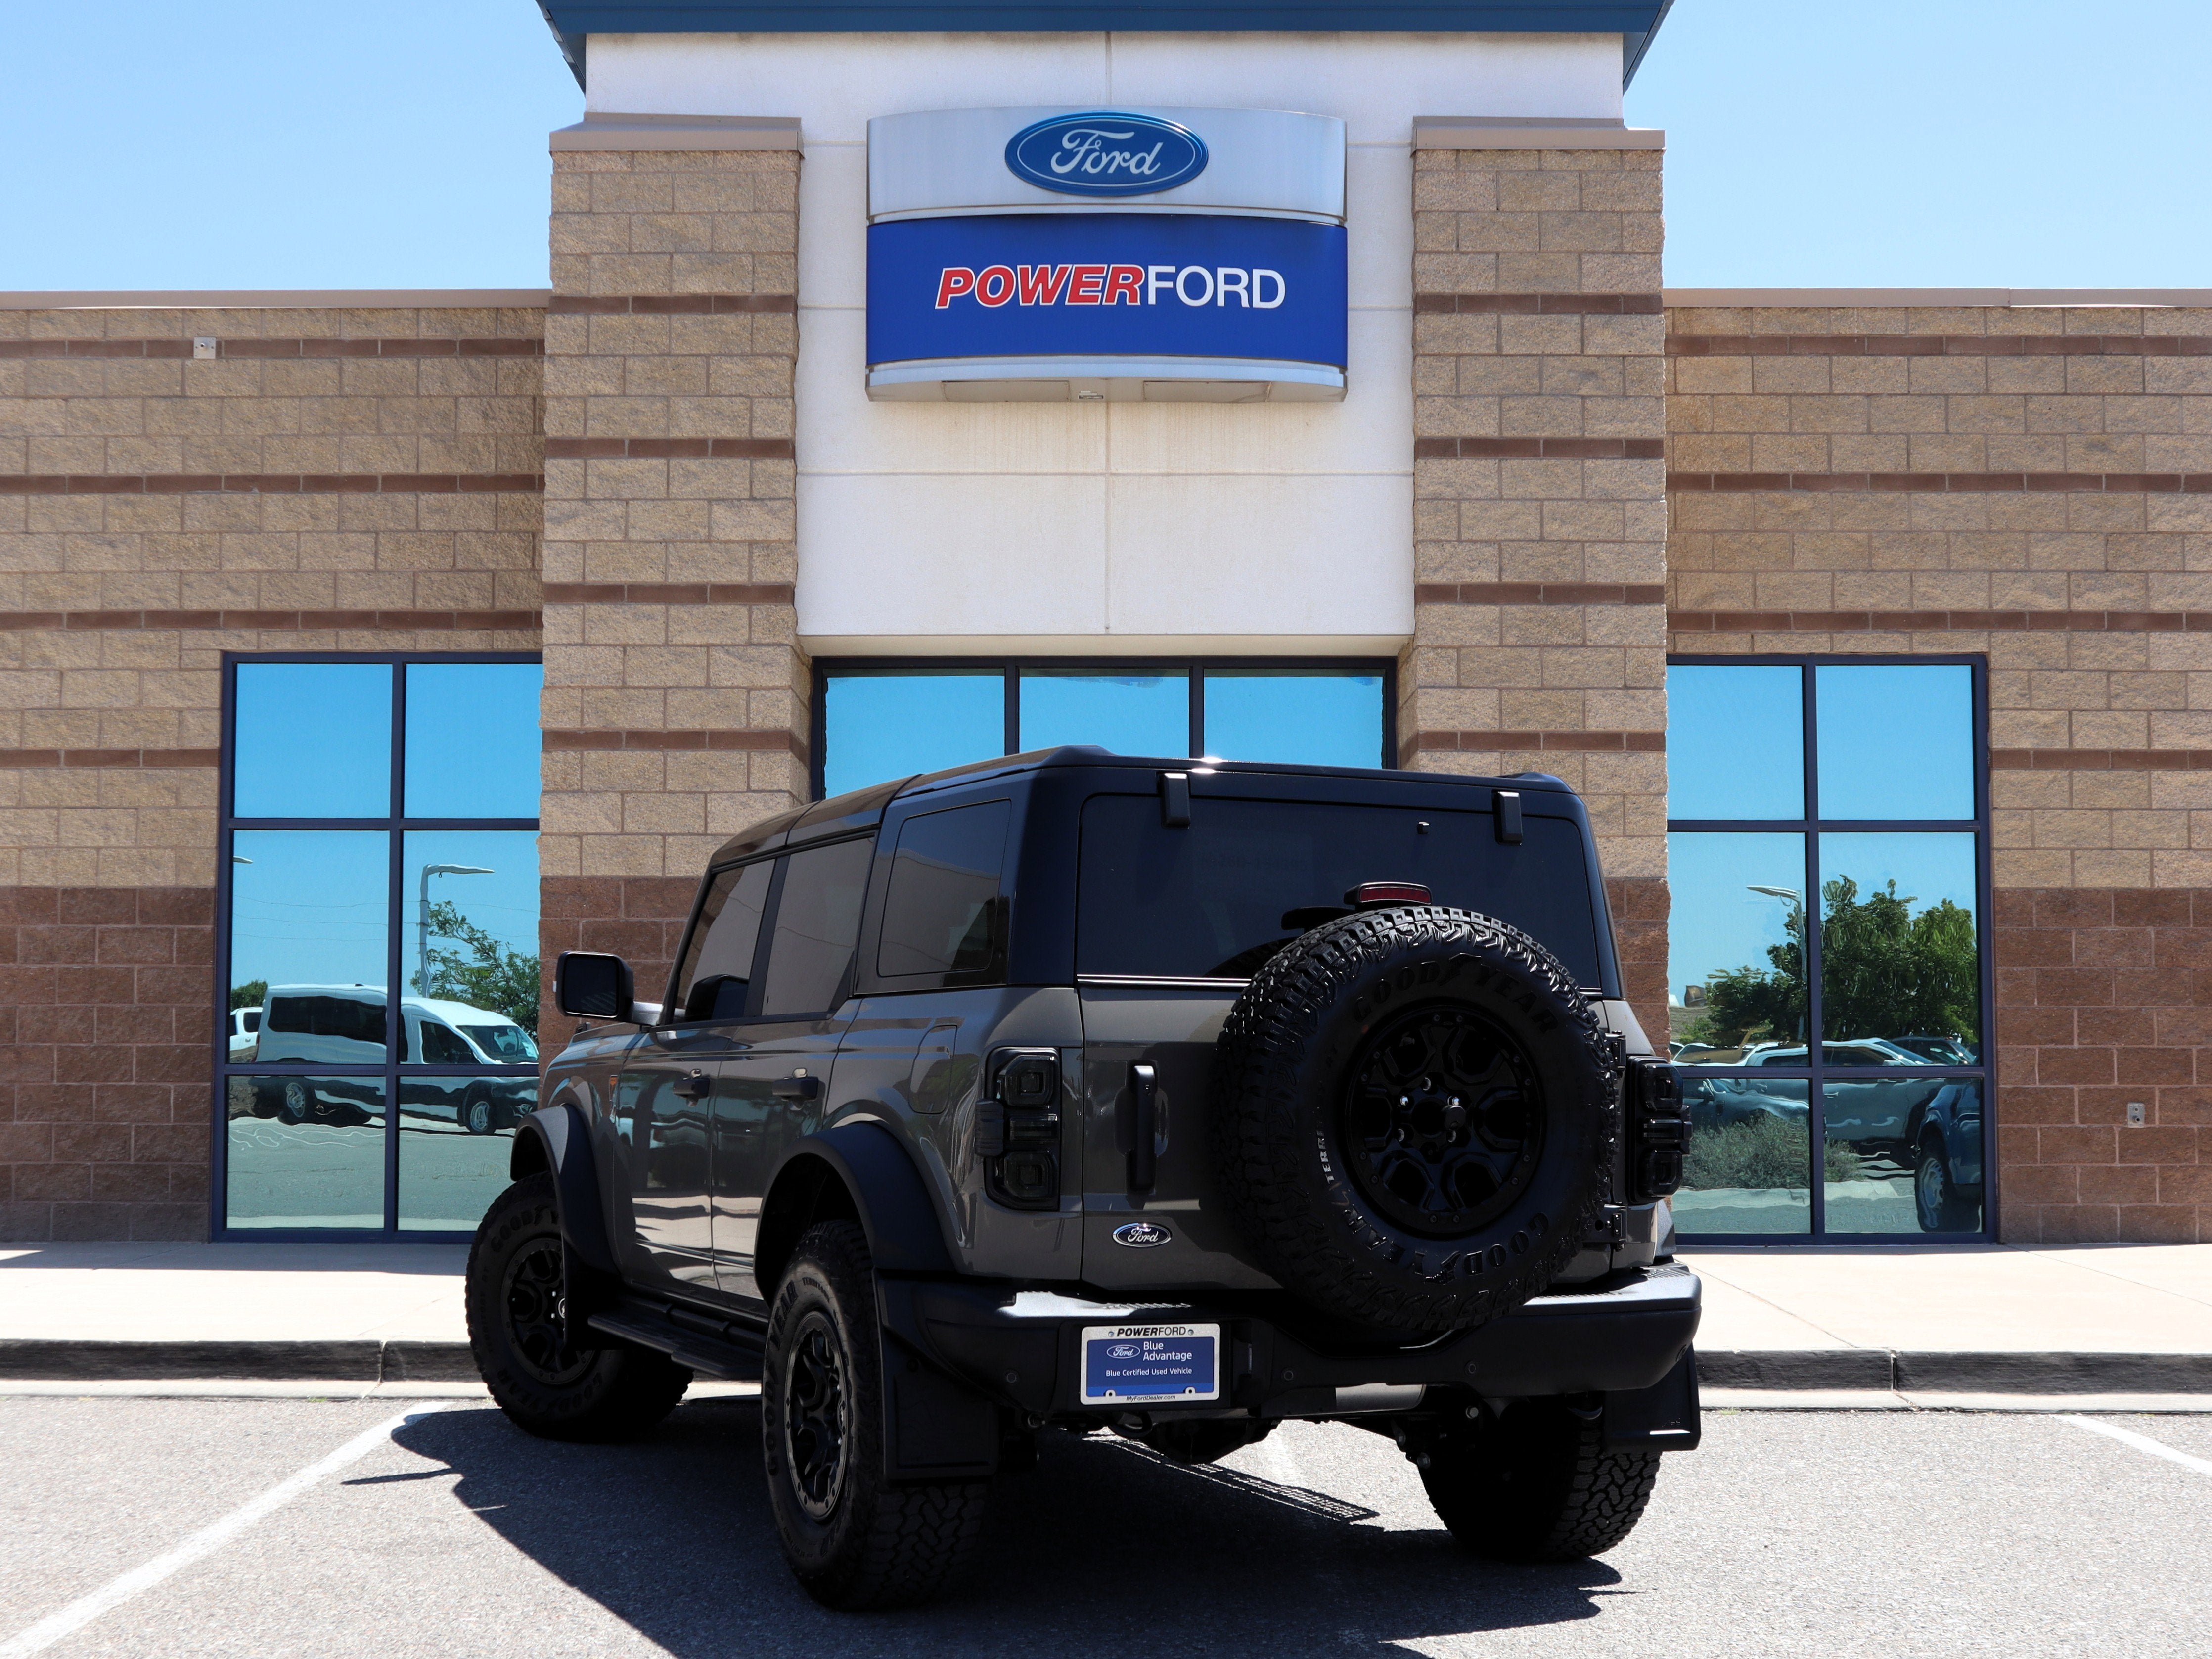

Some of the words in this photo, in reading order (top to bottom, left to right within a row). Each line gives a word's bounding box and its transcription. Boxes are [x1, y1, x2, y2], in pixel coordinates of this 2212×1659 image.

[1050, 128, 1161, 176] Ford
[934, 263, 1286, 310] POWERFORD
[490, 1205, 562, 1253] GOODY
[1127, 1226, 1159, 1242] Ford
[1116, 1326, 1186, 1337] POWERFORD
[1112, 1346, 1134, 1357] Ford
[1143, 1340, 1164, 1351] Blue
[1142, 1351, 1193, 1362] Advantage
